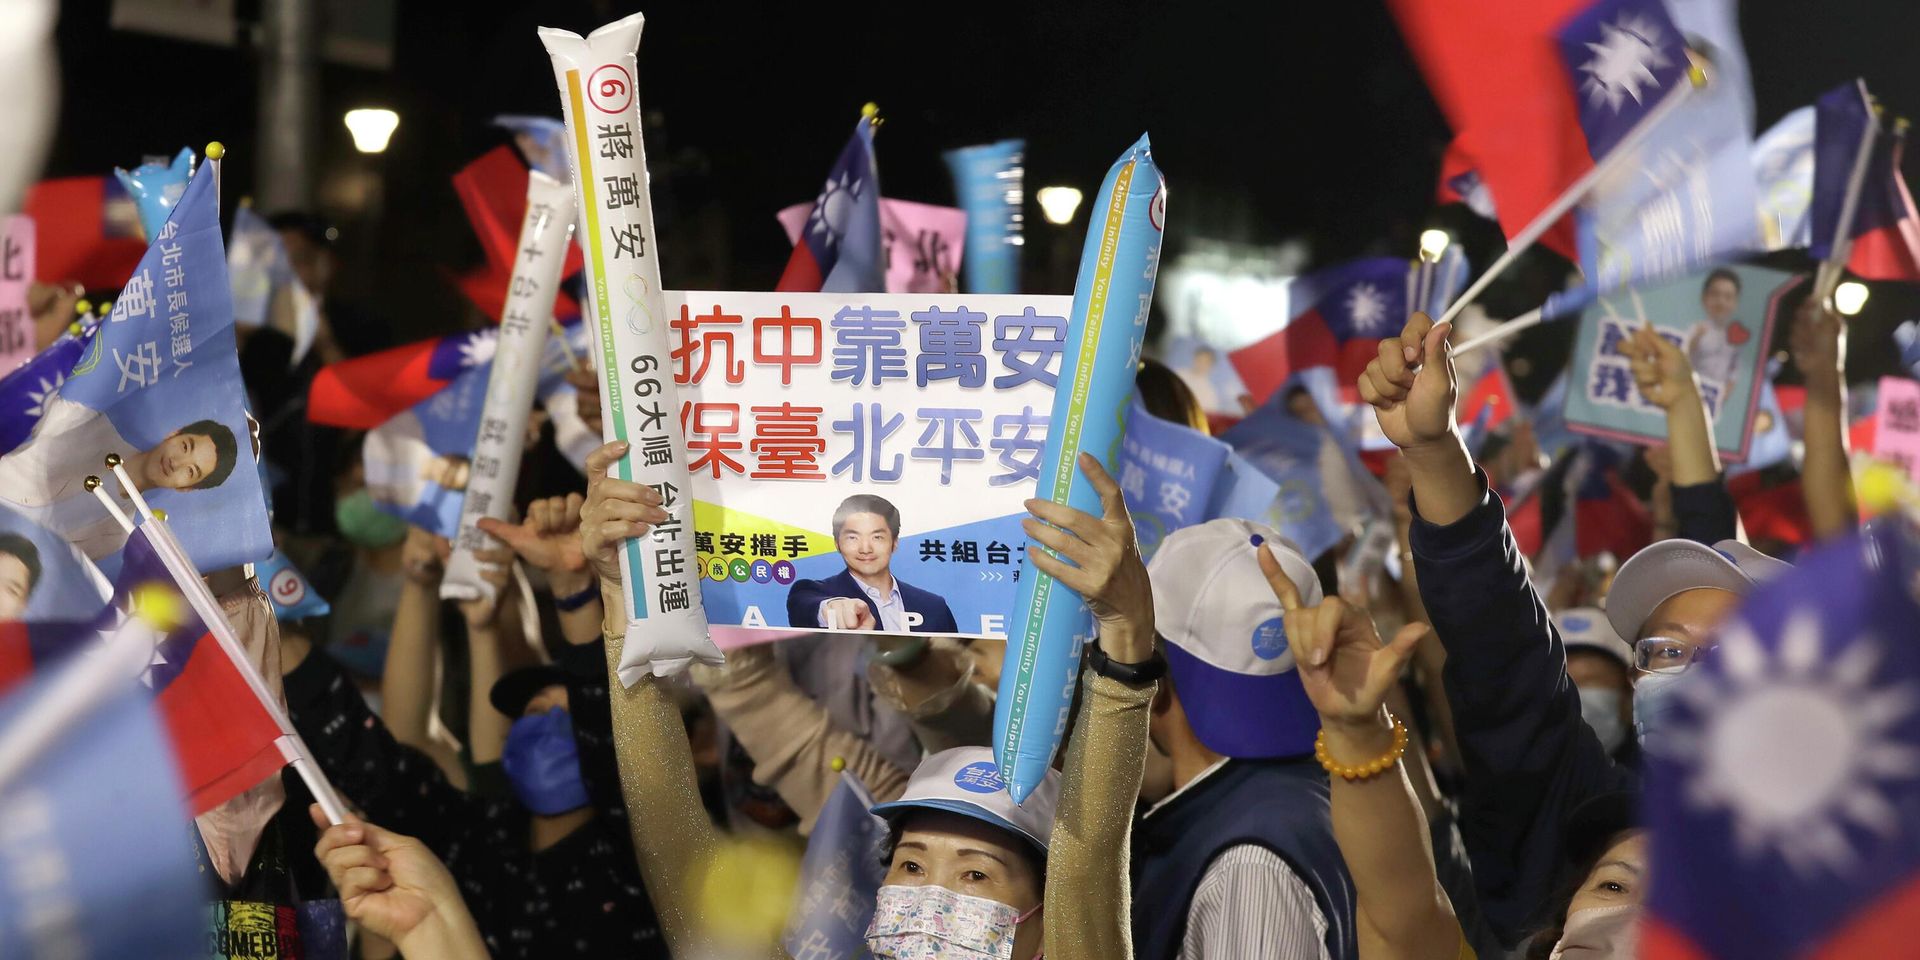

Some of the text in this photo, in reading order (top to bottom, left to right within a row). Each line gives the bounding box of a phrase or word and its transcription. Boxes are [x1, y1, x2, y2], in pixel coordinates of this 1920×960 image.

[597, 122, 645, 259] 蔣萬安
[1113, 178, 1127, 217] Taipei
[1100, 226, 1117, 268] Infinity
[1094, 277, 1107, 300] You
[597, 278, 605, 300] You
[602, 315, 614, 352] Taipei
[608, 367, 620, 412] Infinity
[670, 304, 1068, 390] 抗中靠萬安
[1087, 311, 1100, 348] Taipei
[1073, 359, 1090, 405] Infinity
[631, 354, 673, 467] 66大順
[1069, 413, 1080, 435] You
[680, 401, 1047, 487] 保臺北平安
[1059, 449, 1073, 485] Taipei
[694, 531, 809, 558] 萬安攜手
[1033, 583, 1047, 618] Taipei
[1021, 631, 1037, 674] Infinity
[1016, 682, 1028, 704] You
[1007, 717, 1021, 752] Taipei
